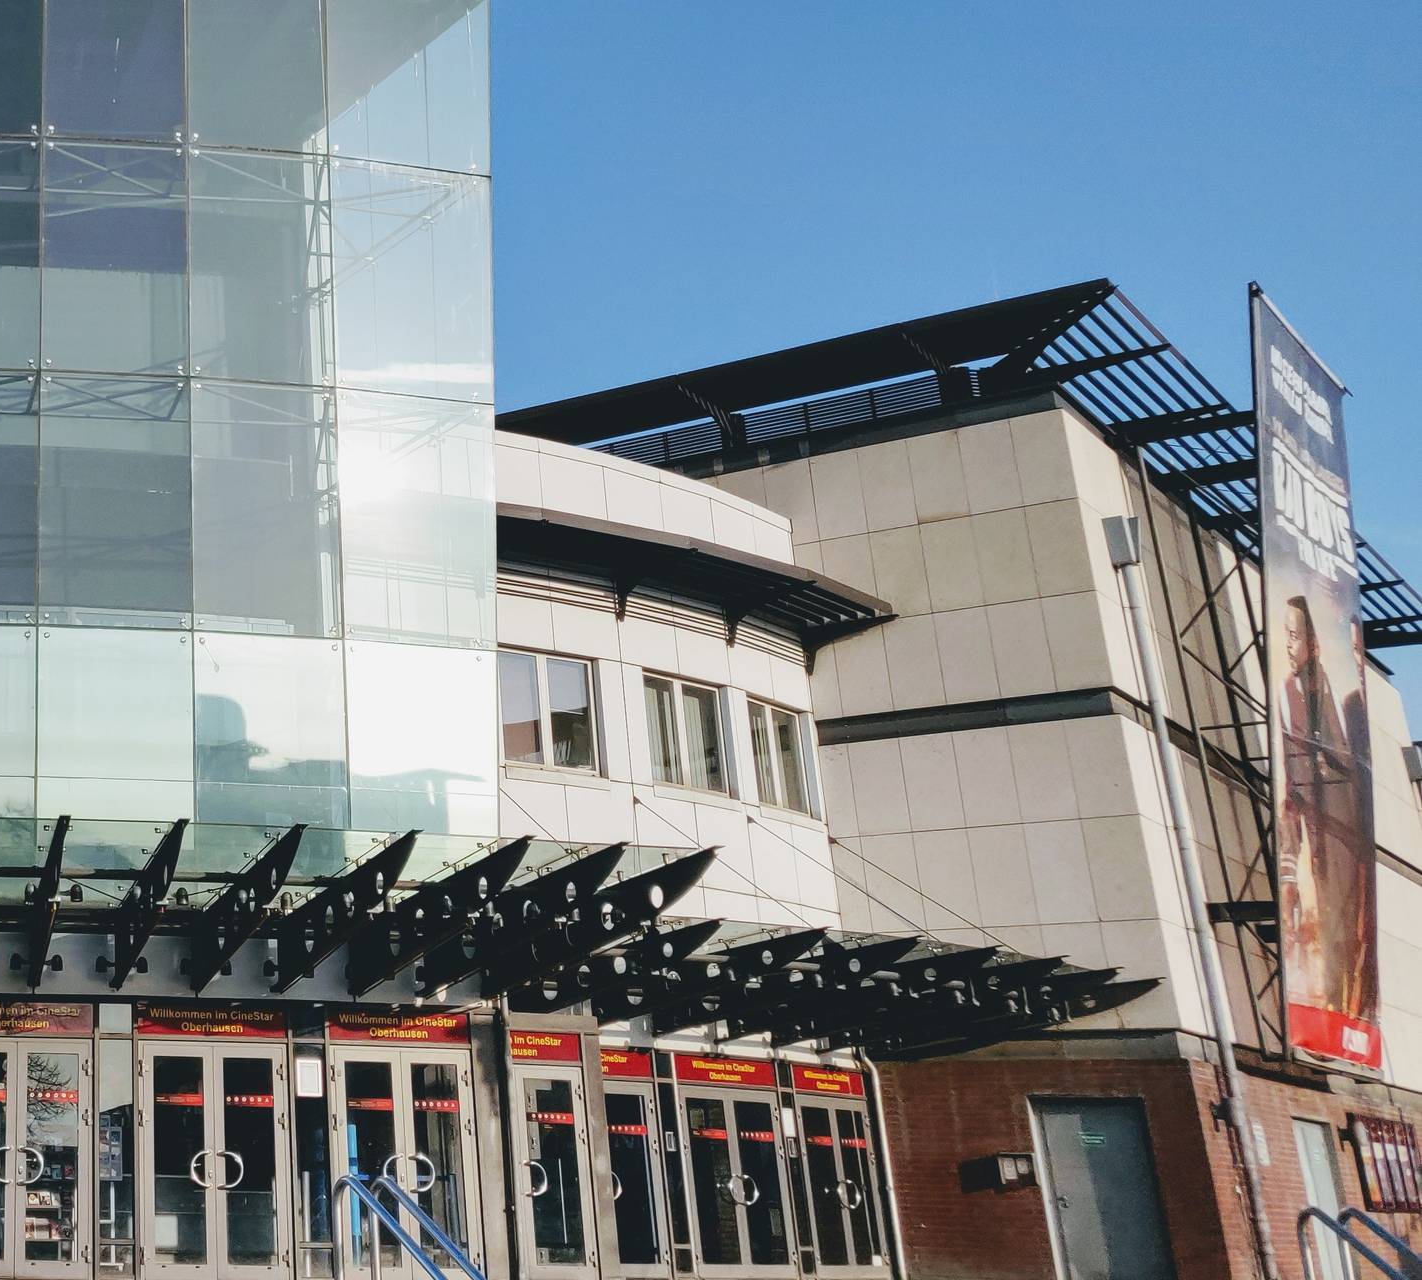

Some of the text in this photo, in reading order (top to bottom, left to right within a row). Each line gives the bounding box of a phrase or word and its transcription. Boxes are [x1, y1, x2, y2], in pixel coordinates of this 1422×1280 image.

[21, 1005, 34, 1016] im
[36, 1007, 81, 1017] CineStar
[149, 1008, 274, 1021] Willkommen im CineStar
[339, 1013, 458, 1027] Willkommen im CineStar
[181, 1022, 243, 1033] Oberhausen
[369, 1027, 429, 1039] Oberhausen
[514, 1035, 524, 1044] im
[526, 1036, 561, 1046] CineStar
